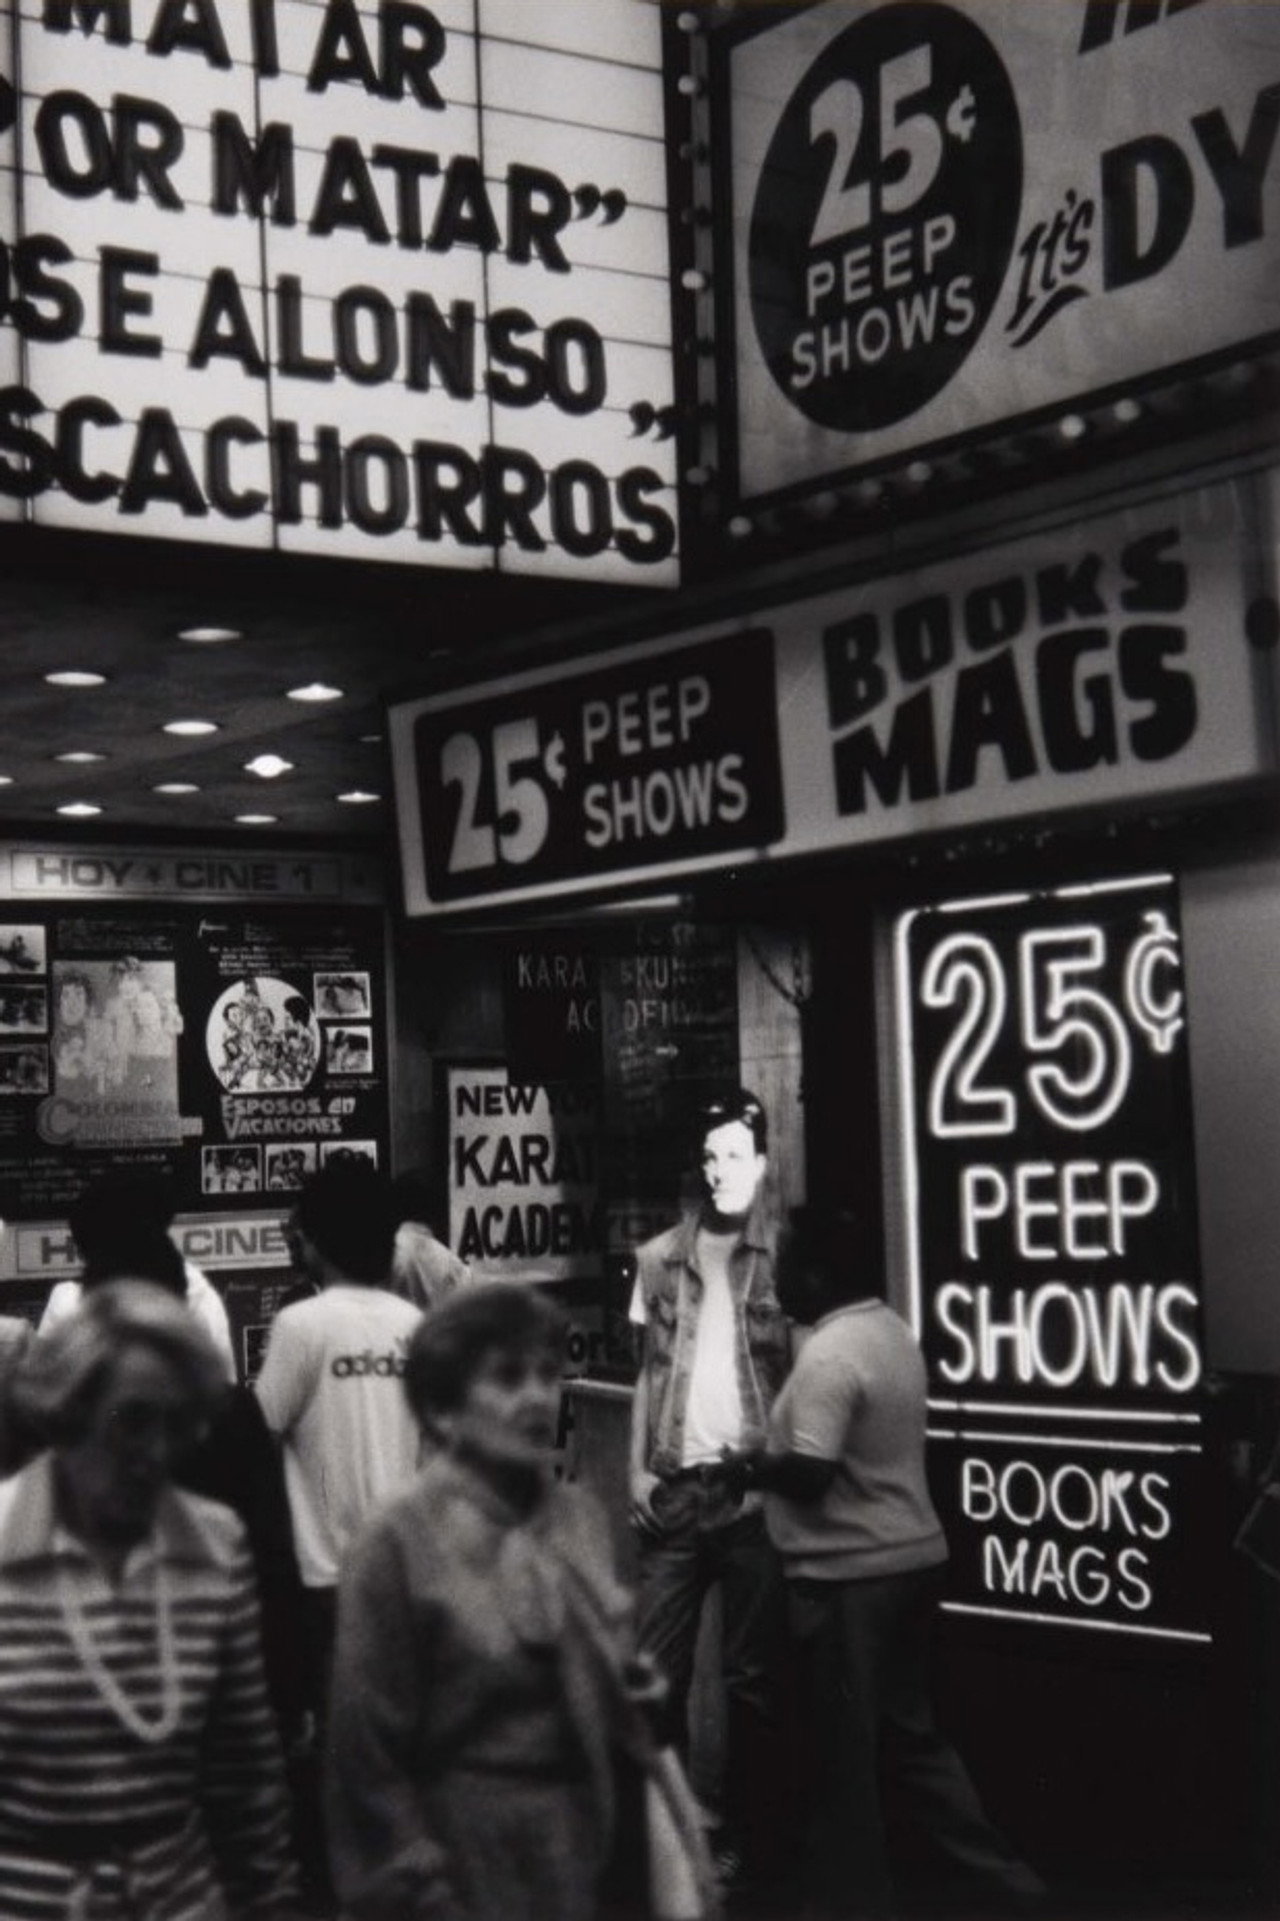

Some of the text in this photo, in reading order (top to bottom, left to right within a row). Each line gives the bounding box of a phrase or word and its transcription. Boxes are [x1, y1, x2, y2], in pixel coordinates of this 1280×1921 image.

[0, 76, 184, 212] OR
[810, 43, 977, 248] 25¢
[807, 214, 956, 316] PEEP
[0, 233, 607, 416] SE ALONSO
[791, 275, 976, 389] SHOWS
[823, 527, 1189, 732] BOOKS
[582, 675, 711, 763] PEEP
[831, 624, 1199, 817] MAGS
[440, 717, 567, 875] 25¢
[584, 753, 749, 849] SHOWS
[36, 857, 134, 888] HOY
[175, 860, 278, 891] CINE
[922, 911, 1184, 1138] 25¢
[456, 1085, 538, 1117] NEW
[182, 1226, 287, 1257] CINE
[961, 1160, 1159, 1261] PEEP
[935, 1282, 1200, 1391] SHOWS
[961, 1458, 1172, 1541] BOOKS
[983, 1537, 1152, 1610] MAGS
